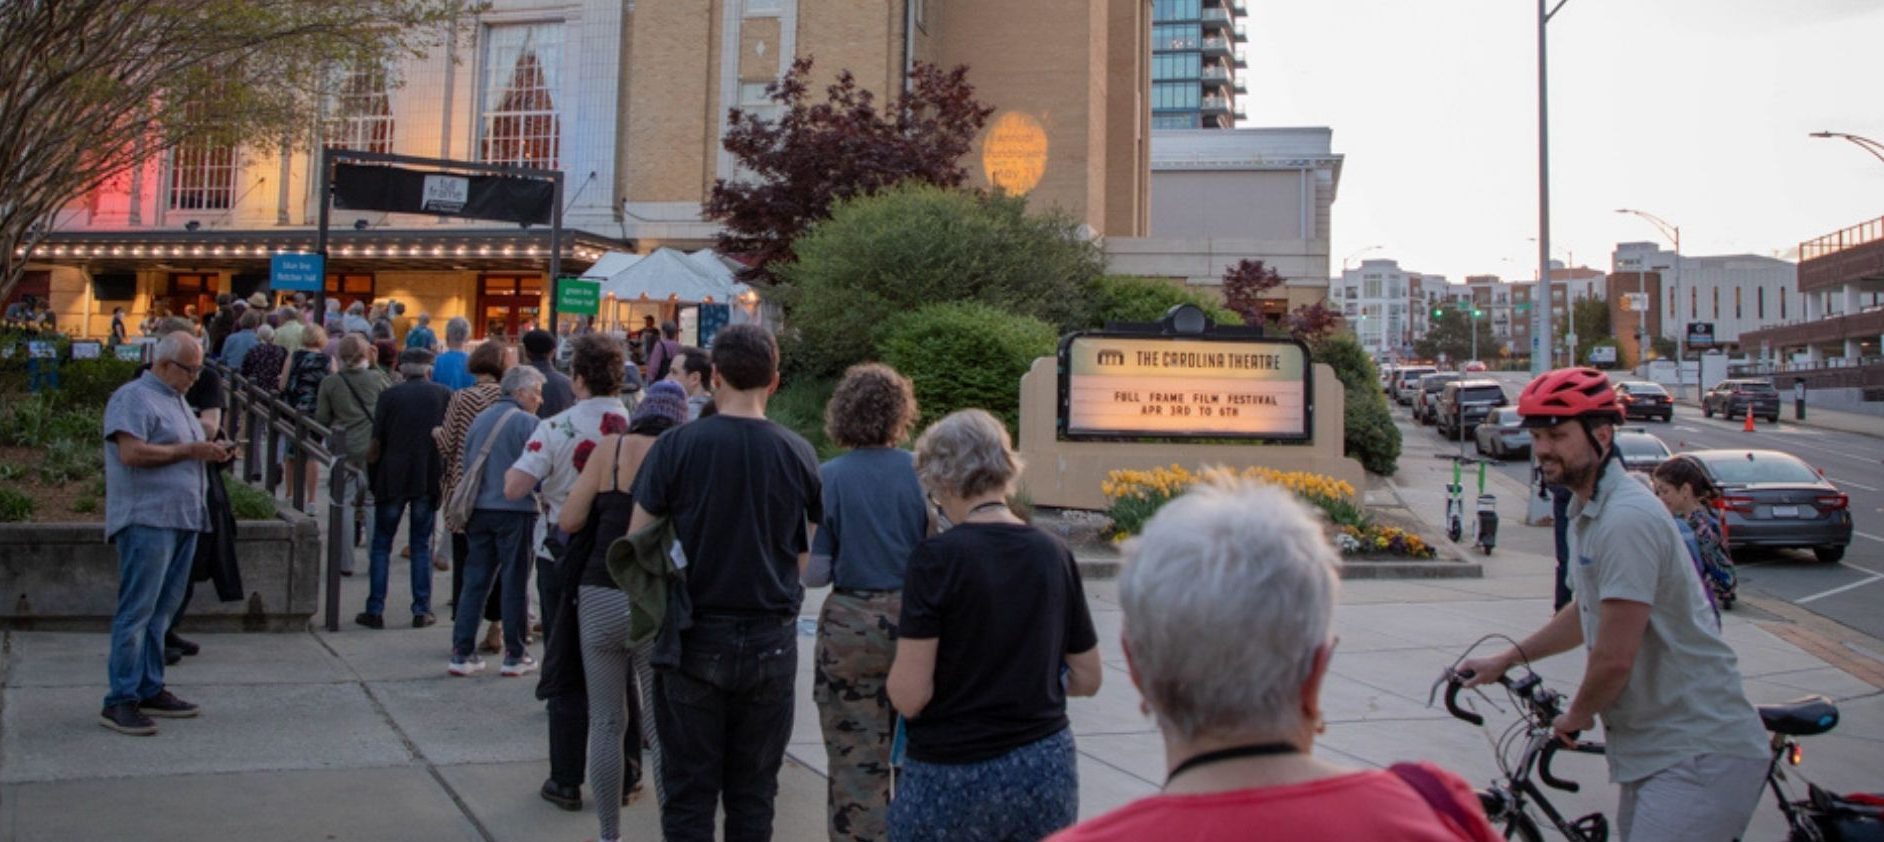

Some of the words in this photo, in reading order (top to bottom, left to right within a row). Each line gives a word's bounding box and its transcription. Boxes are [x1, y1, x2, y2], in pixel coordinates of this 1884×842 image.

[1136, 350, 1159, 366] THE
[1162, 351, 1224, 368] CAROLINA
[1228, 353, 1280, 370] THEATRE
[1114, 391, 1140, 402] FULL
[1149, 392, 1184, 403] FRAME
[1193, 393, 1219, 404] FILM
[1228, 394, 1278, 406] FESTIVAL
[1141, 405, 1163, 415] APR
[1170, 405, 1191, 416] 3RD
[1199, 406, 1212, 416] TO
[1219, 407, 1239, 417] 6TH
